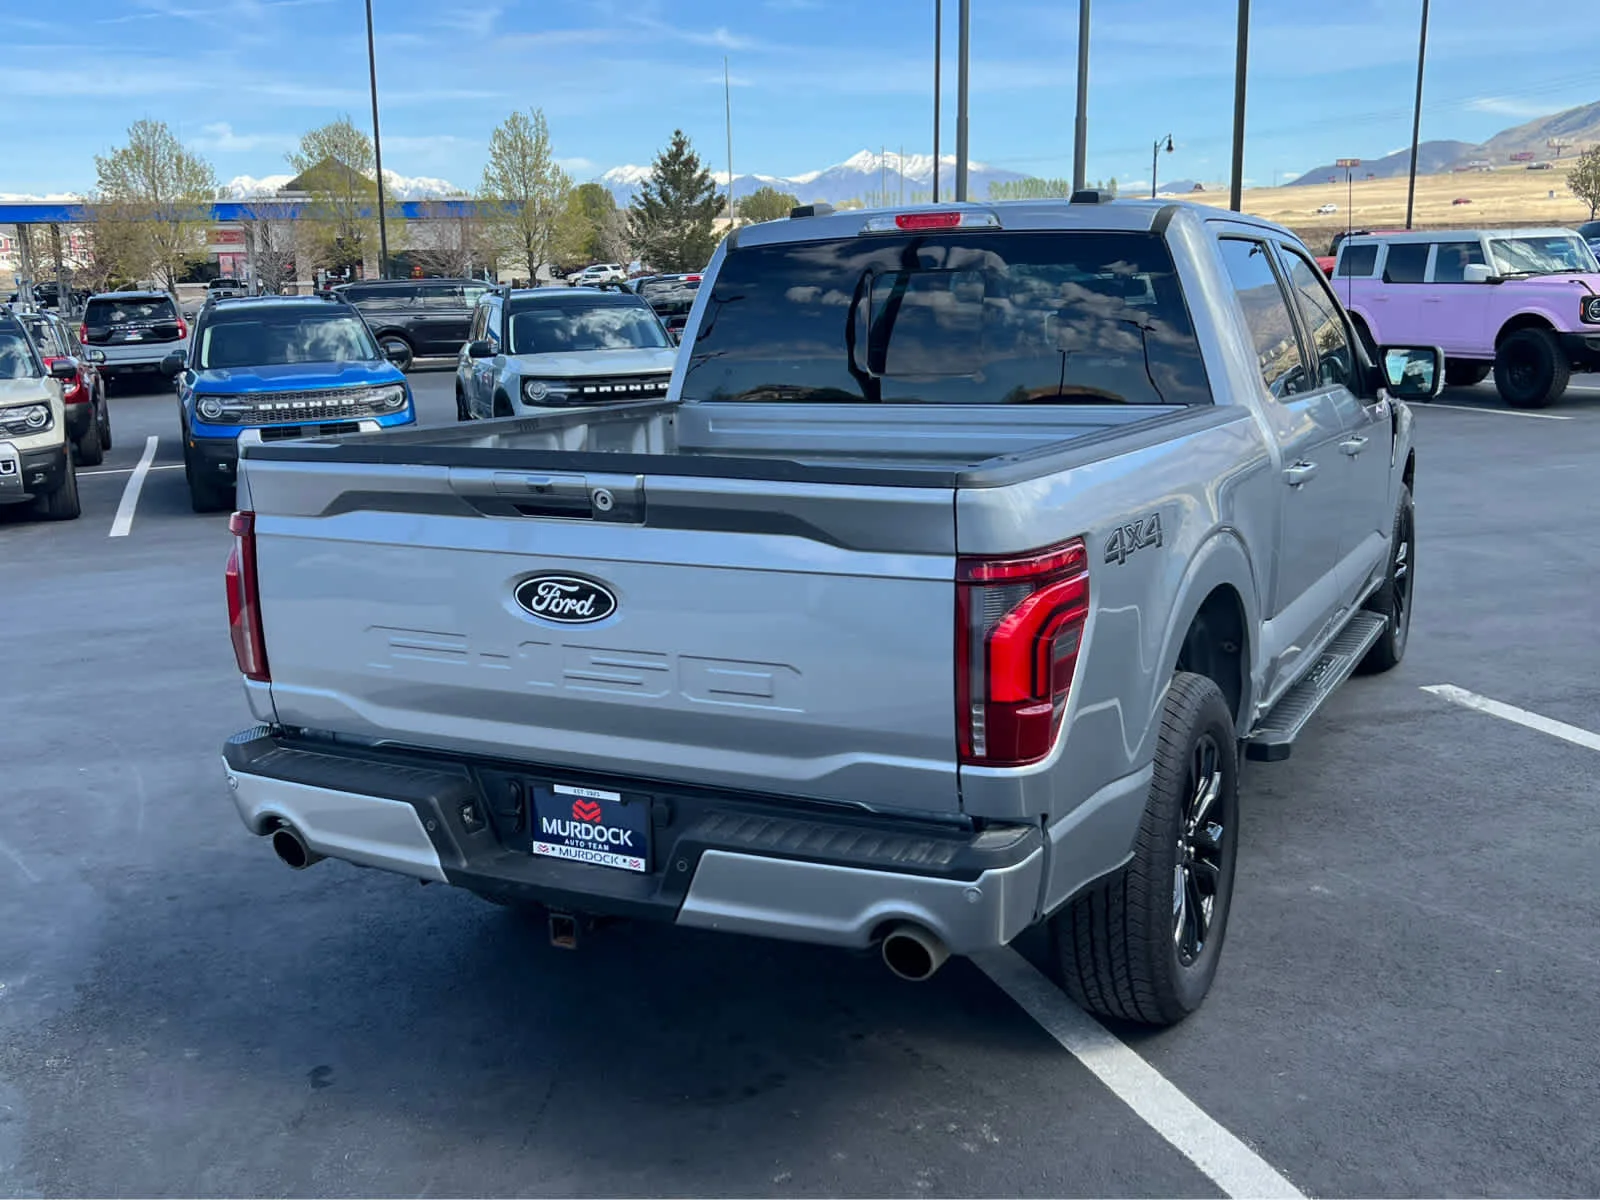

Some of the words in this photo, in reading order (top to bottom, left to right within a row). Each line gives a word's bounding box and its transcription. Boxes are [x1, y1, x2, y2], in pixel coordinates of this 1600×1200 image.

[531, 581, 596, 617] Ford
[542, 816, 633, 847] MURDOCK
[560, 846, 619, 865] MURDOCK
[564, 838, 585, 848] AUTO
[588, 842, 610, 851] TEAM
